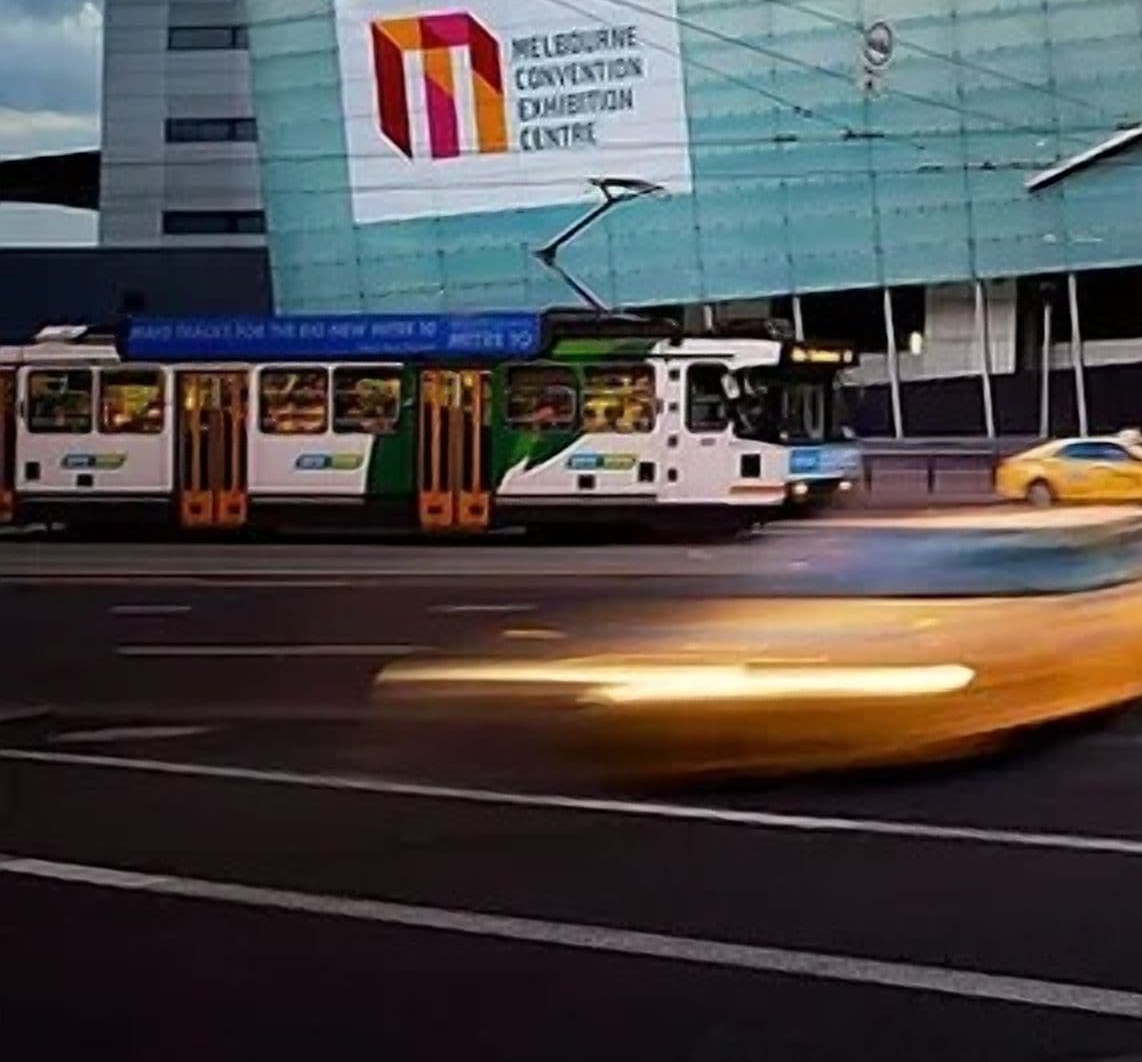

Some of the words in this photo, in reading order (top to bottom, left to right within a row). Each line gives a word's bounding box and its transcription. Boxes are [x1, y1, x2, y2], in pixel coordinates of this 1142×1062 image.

[511, 25, 638, 59] MELBOURNE
[515, 57, 642, 91] CONVENTION
[518, 88, 633, 123] EXHIBITION
[520, 121, 597, 151] CENTRE
